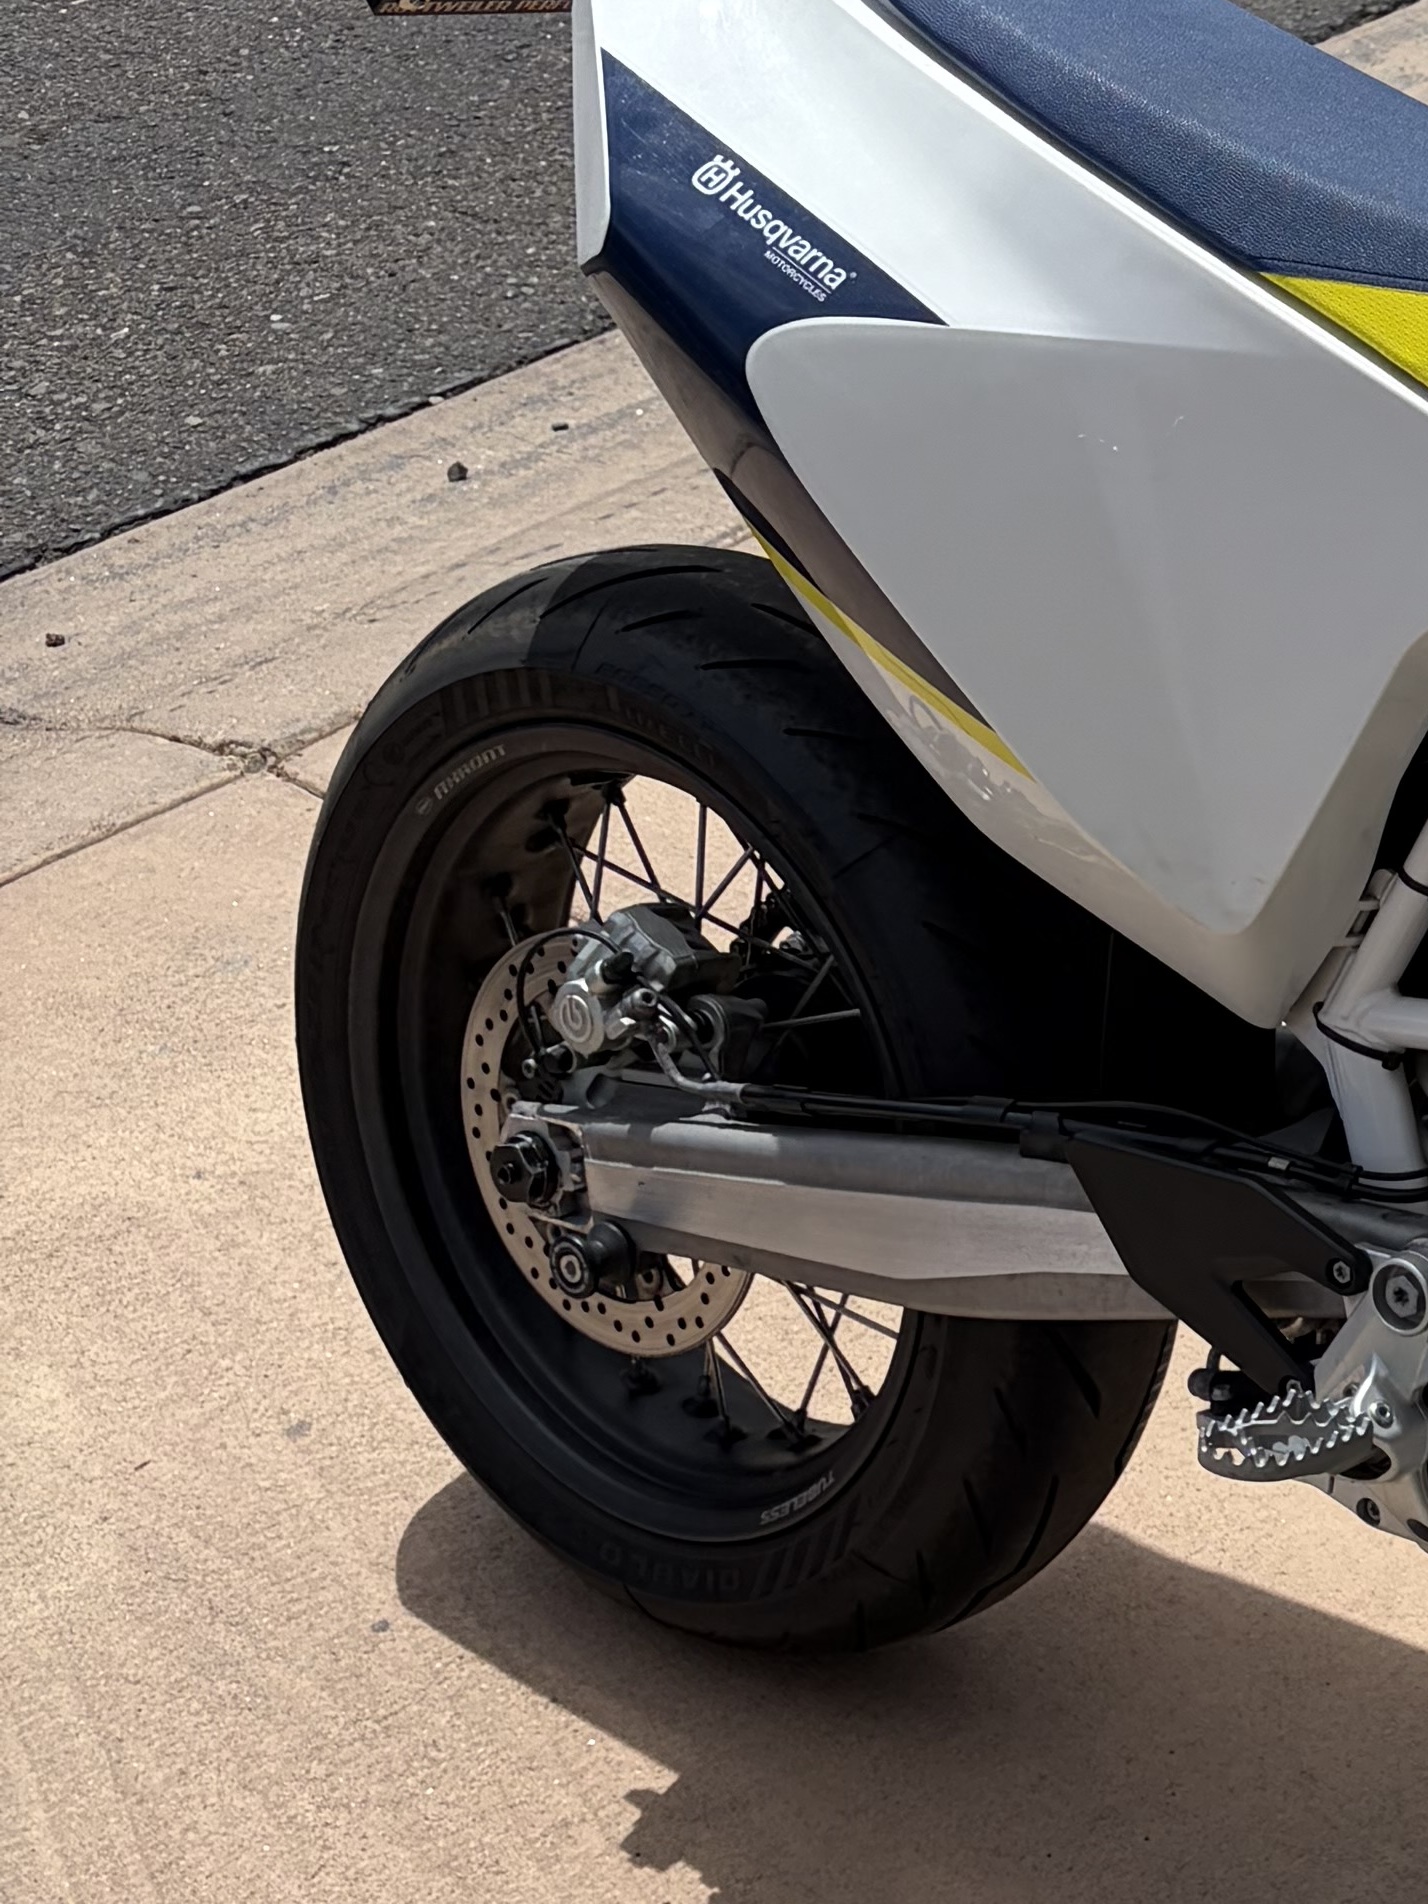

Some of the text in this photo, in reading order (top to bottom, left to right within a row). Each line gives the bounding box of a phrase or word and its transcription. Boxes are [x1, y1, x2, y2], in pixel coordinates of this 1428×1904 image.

[718, 181, 848, 290] Husqvarna
[763, 250, 828, 302] MOTORCYCLES
[759, 1470, 835, 1526] TUBELESS
